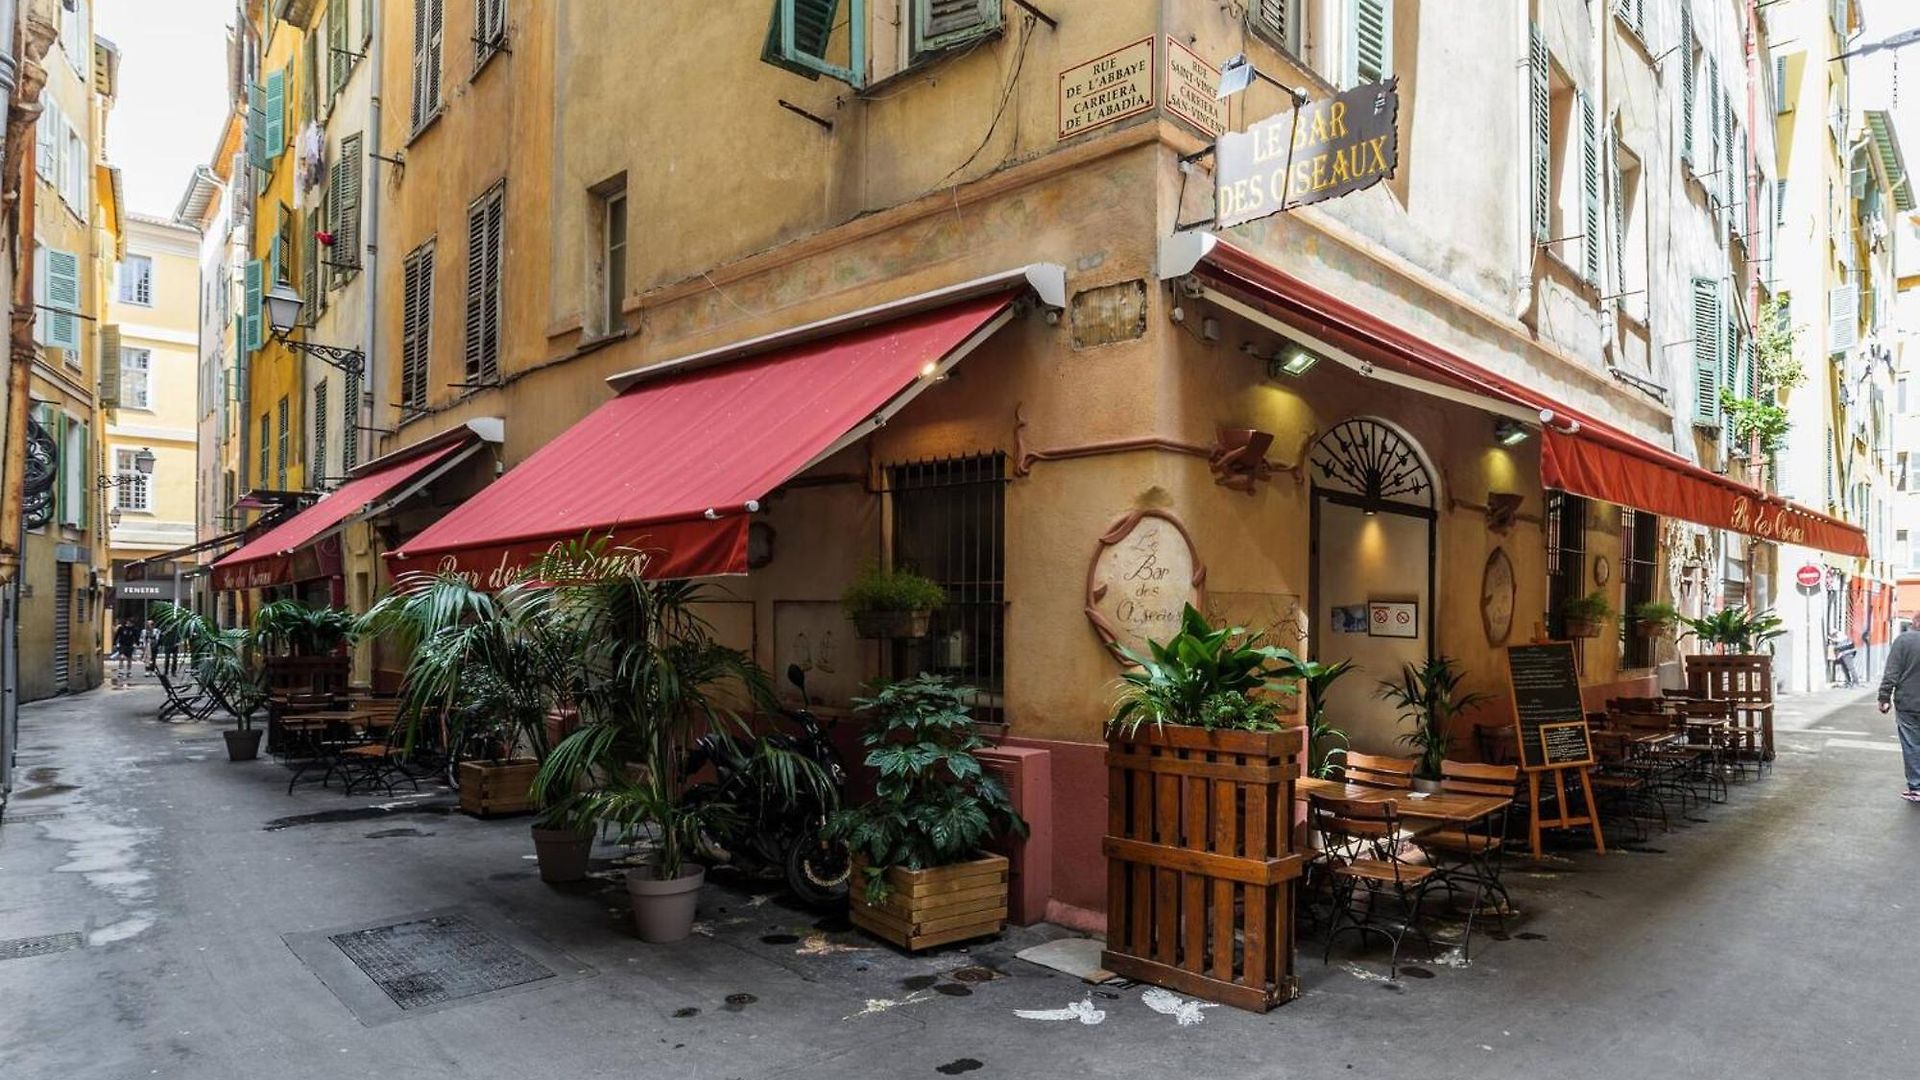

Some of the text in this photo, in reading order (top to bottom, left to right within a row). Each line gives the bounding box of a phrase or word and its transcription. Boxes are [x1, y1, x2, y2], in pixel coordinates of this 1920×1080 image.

[1066, 60, 1145, 98] DE L'ABBAYE
[1093, 58, 1117, 75] RUE
[1192, 61, 1207, 79] RUE
[1073, 83, 1137, 113] CARRIERA
[1180, 86, 1218, 118] CARRIERA
[1066, 116, 1081, 130] DE
[1253, 101, 1349, 162] LE BAR
[1220, 135, 1390, 218] DES OISEAUX
[1123, 554, 1169, 580] Bar
[1135, 584, 1160, 597] des
